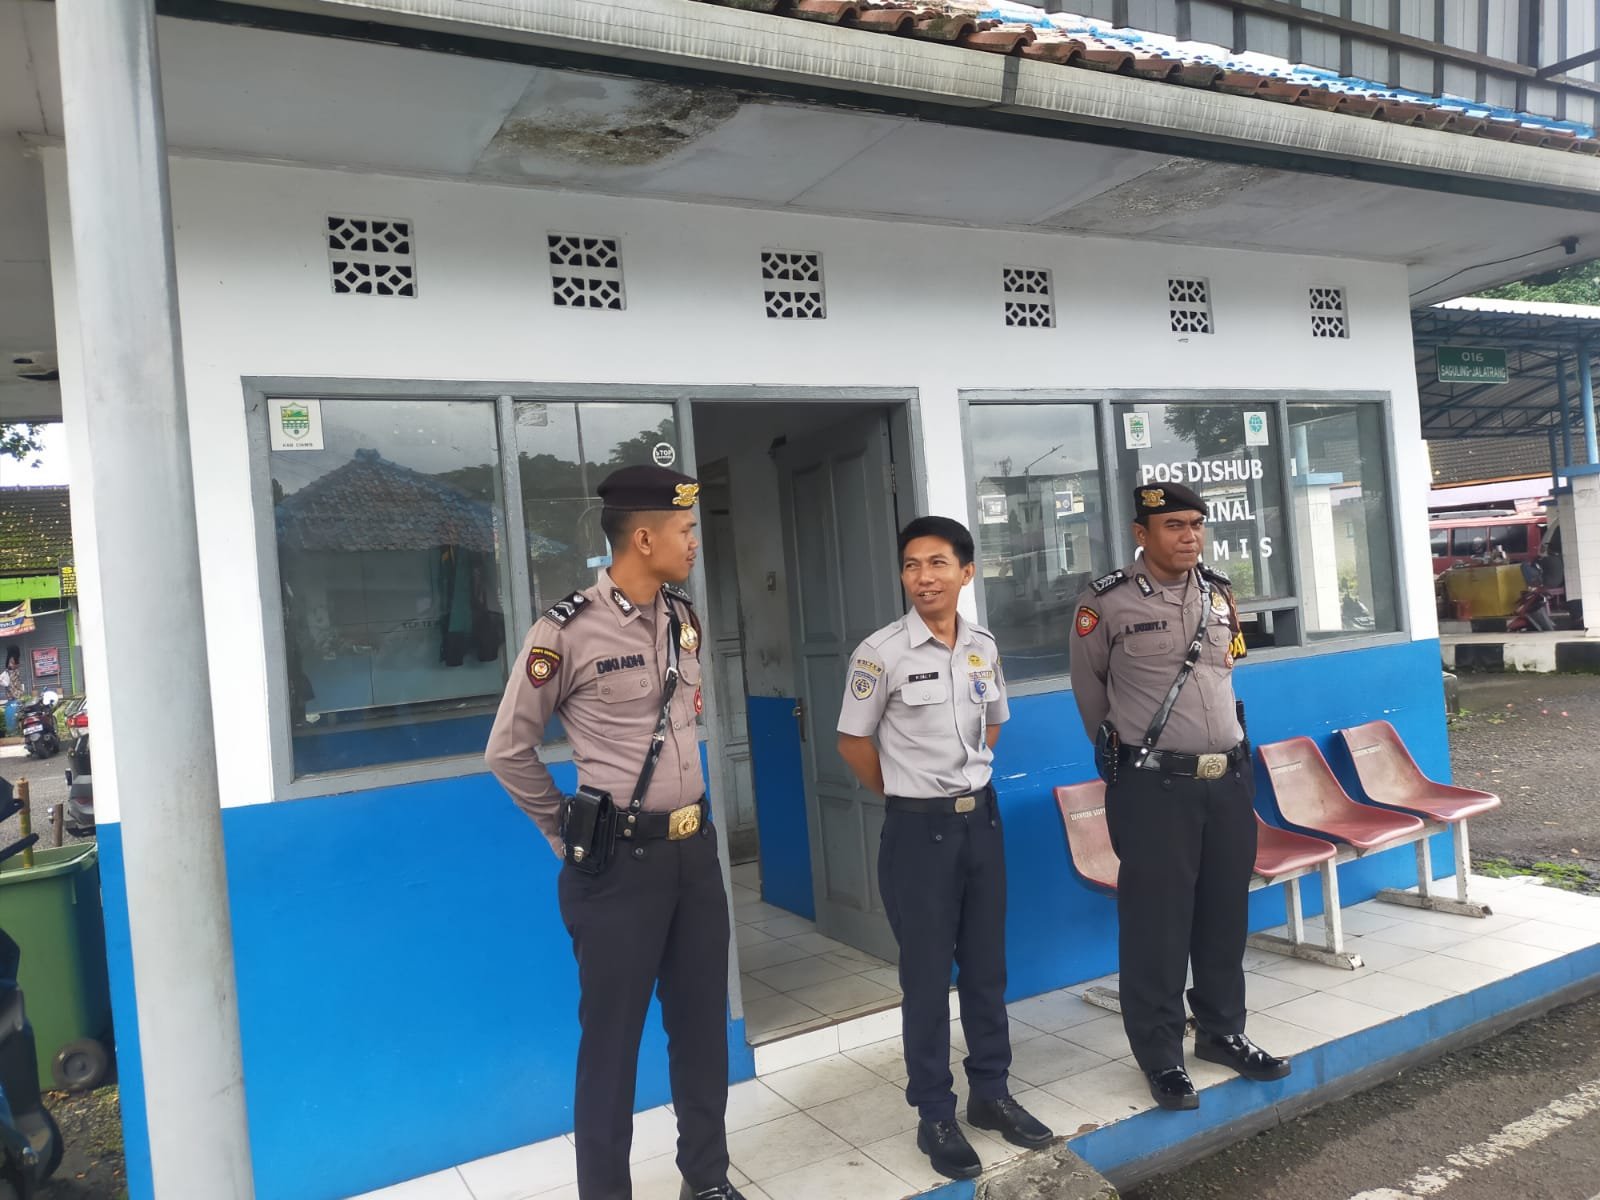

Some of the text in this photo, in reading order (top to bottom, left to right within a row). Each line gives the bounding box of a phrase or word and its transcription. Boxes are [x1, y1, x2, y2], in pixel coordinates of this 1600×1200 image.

[1461, 351, 1484, 362] 016
[655, 448, 673, 457] STOP
[1141, 459, 1264, 485] POS DISHUB
[1204, 499, 1256, 522] INAL
